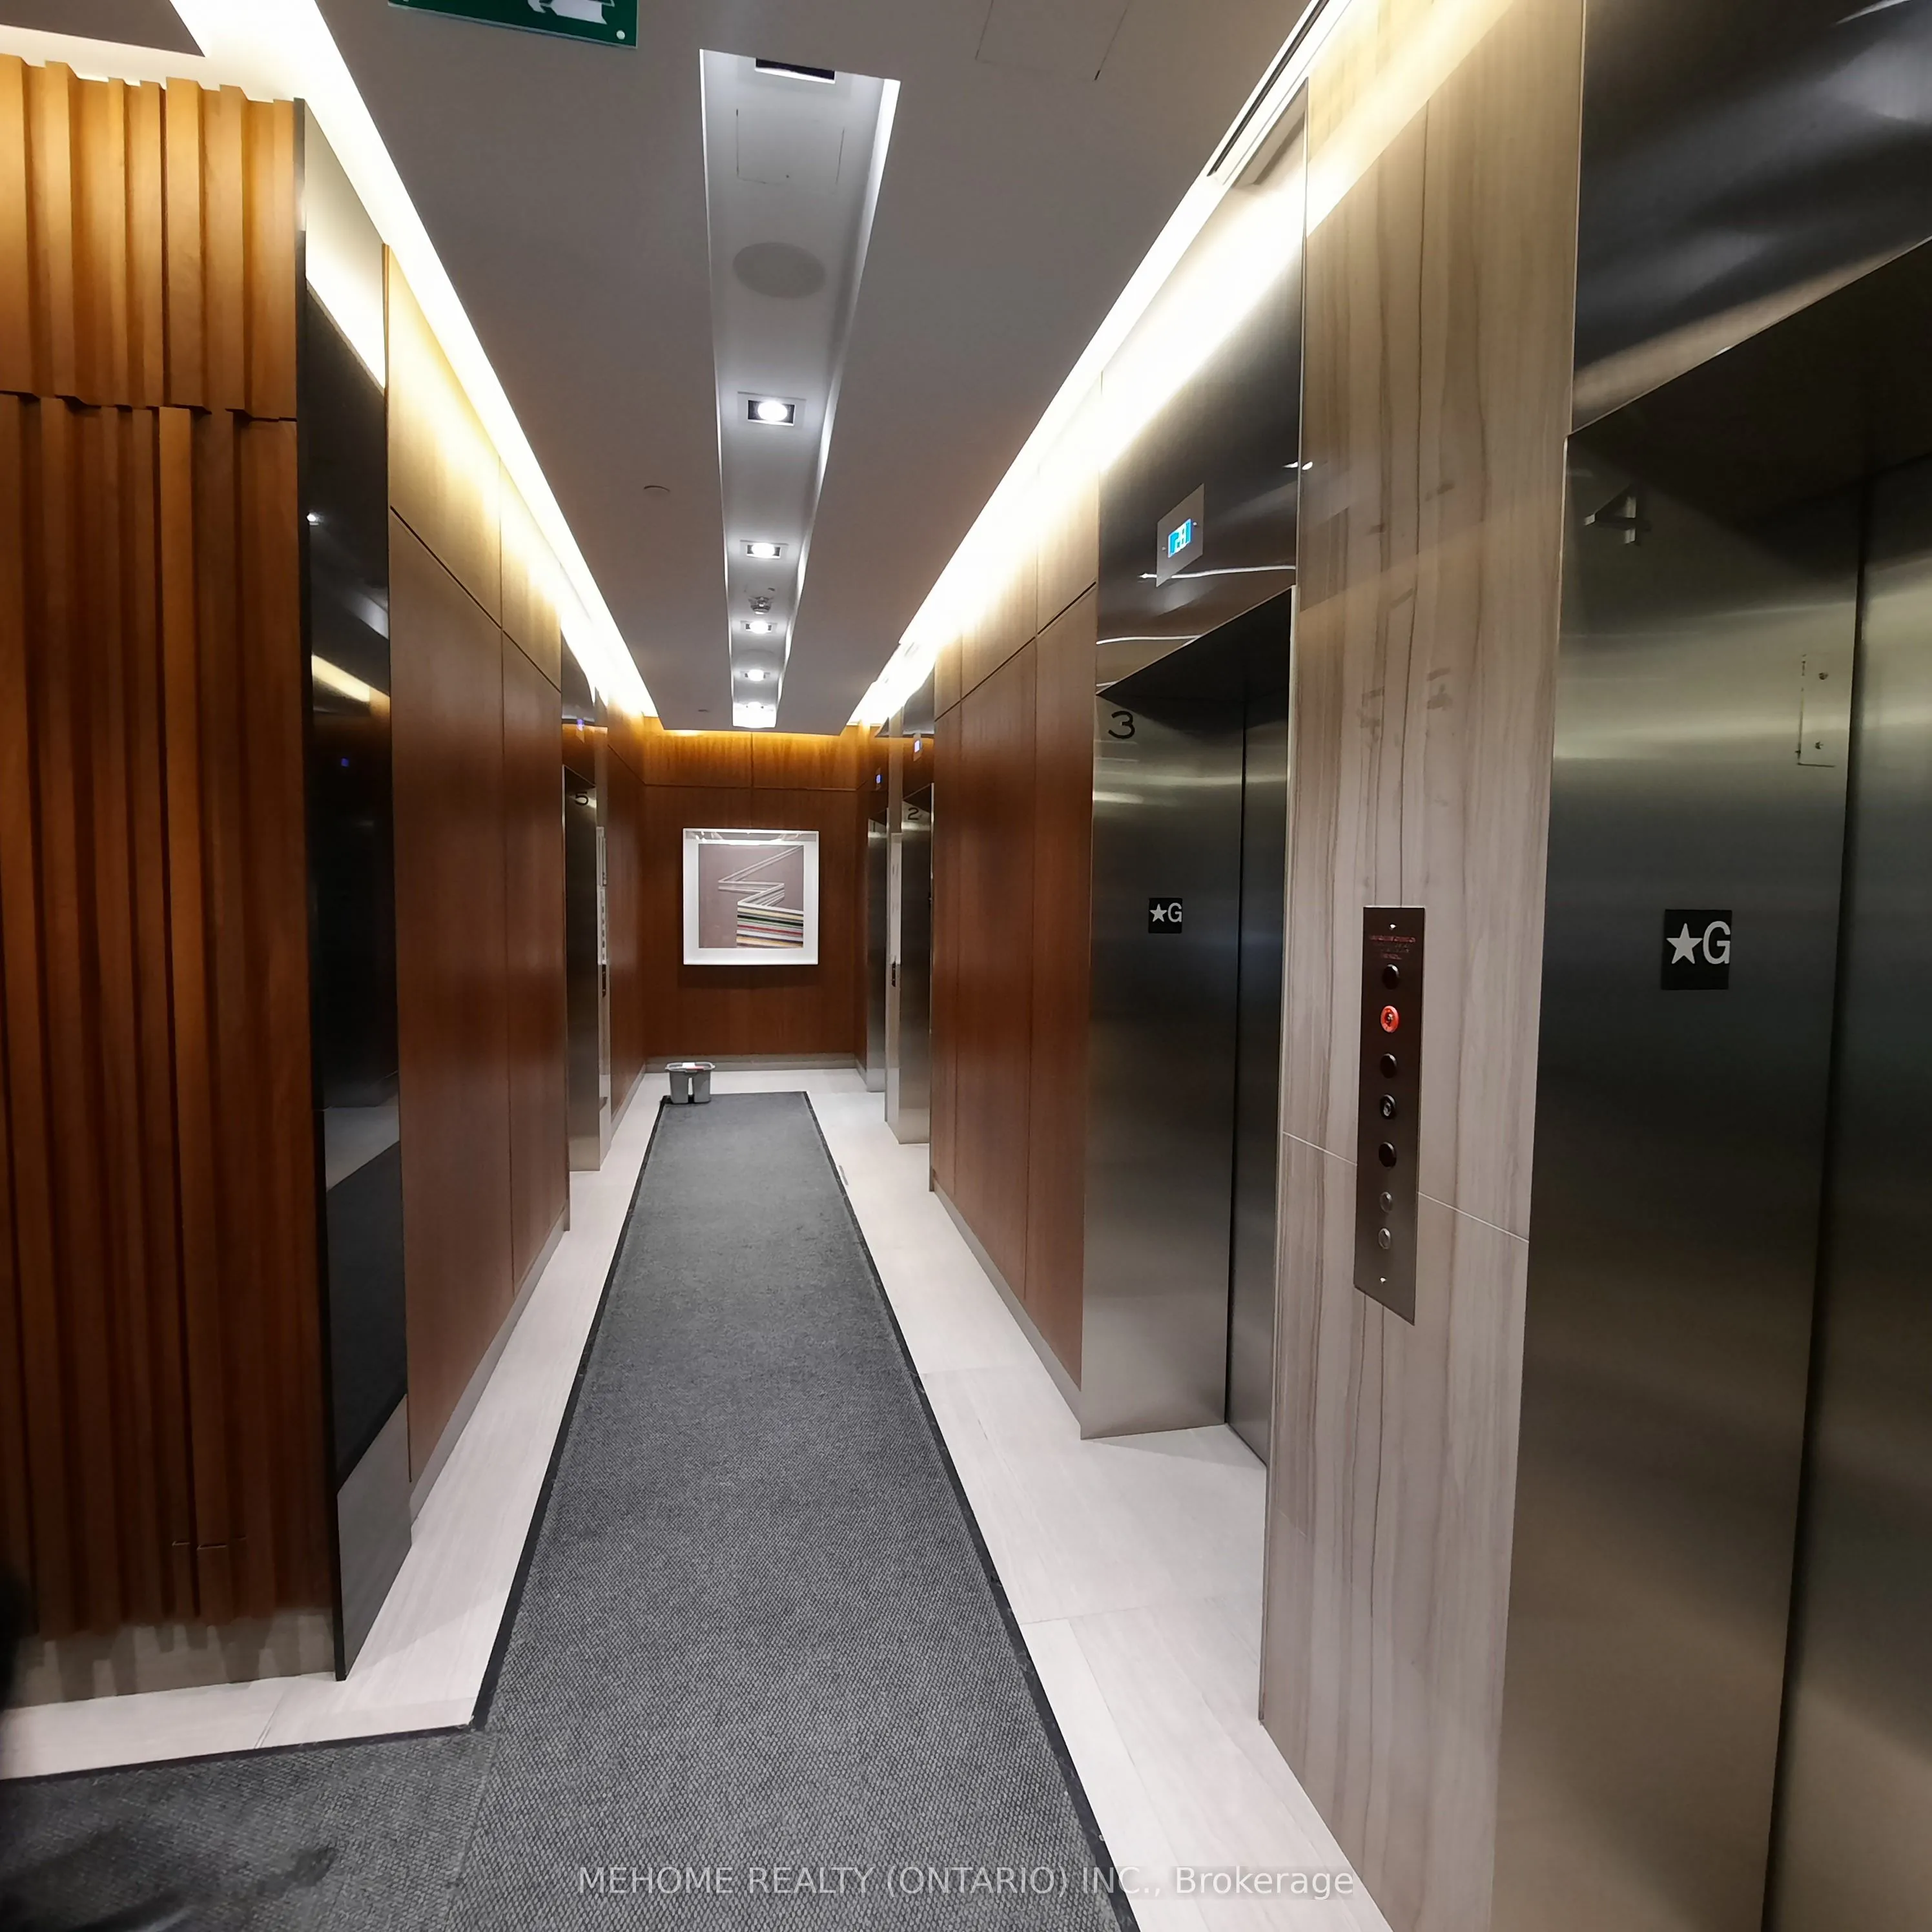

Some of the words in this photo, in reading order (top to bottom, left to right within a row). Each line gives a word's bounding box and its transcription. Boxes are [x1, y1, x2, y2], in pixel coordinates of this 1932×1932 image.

[1583, 487, 1650, 544] 4
[1108, 710, 1135, 739] 3
[575, 791, 589, 806] 5
[907, 807, 920, 821] 2
